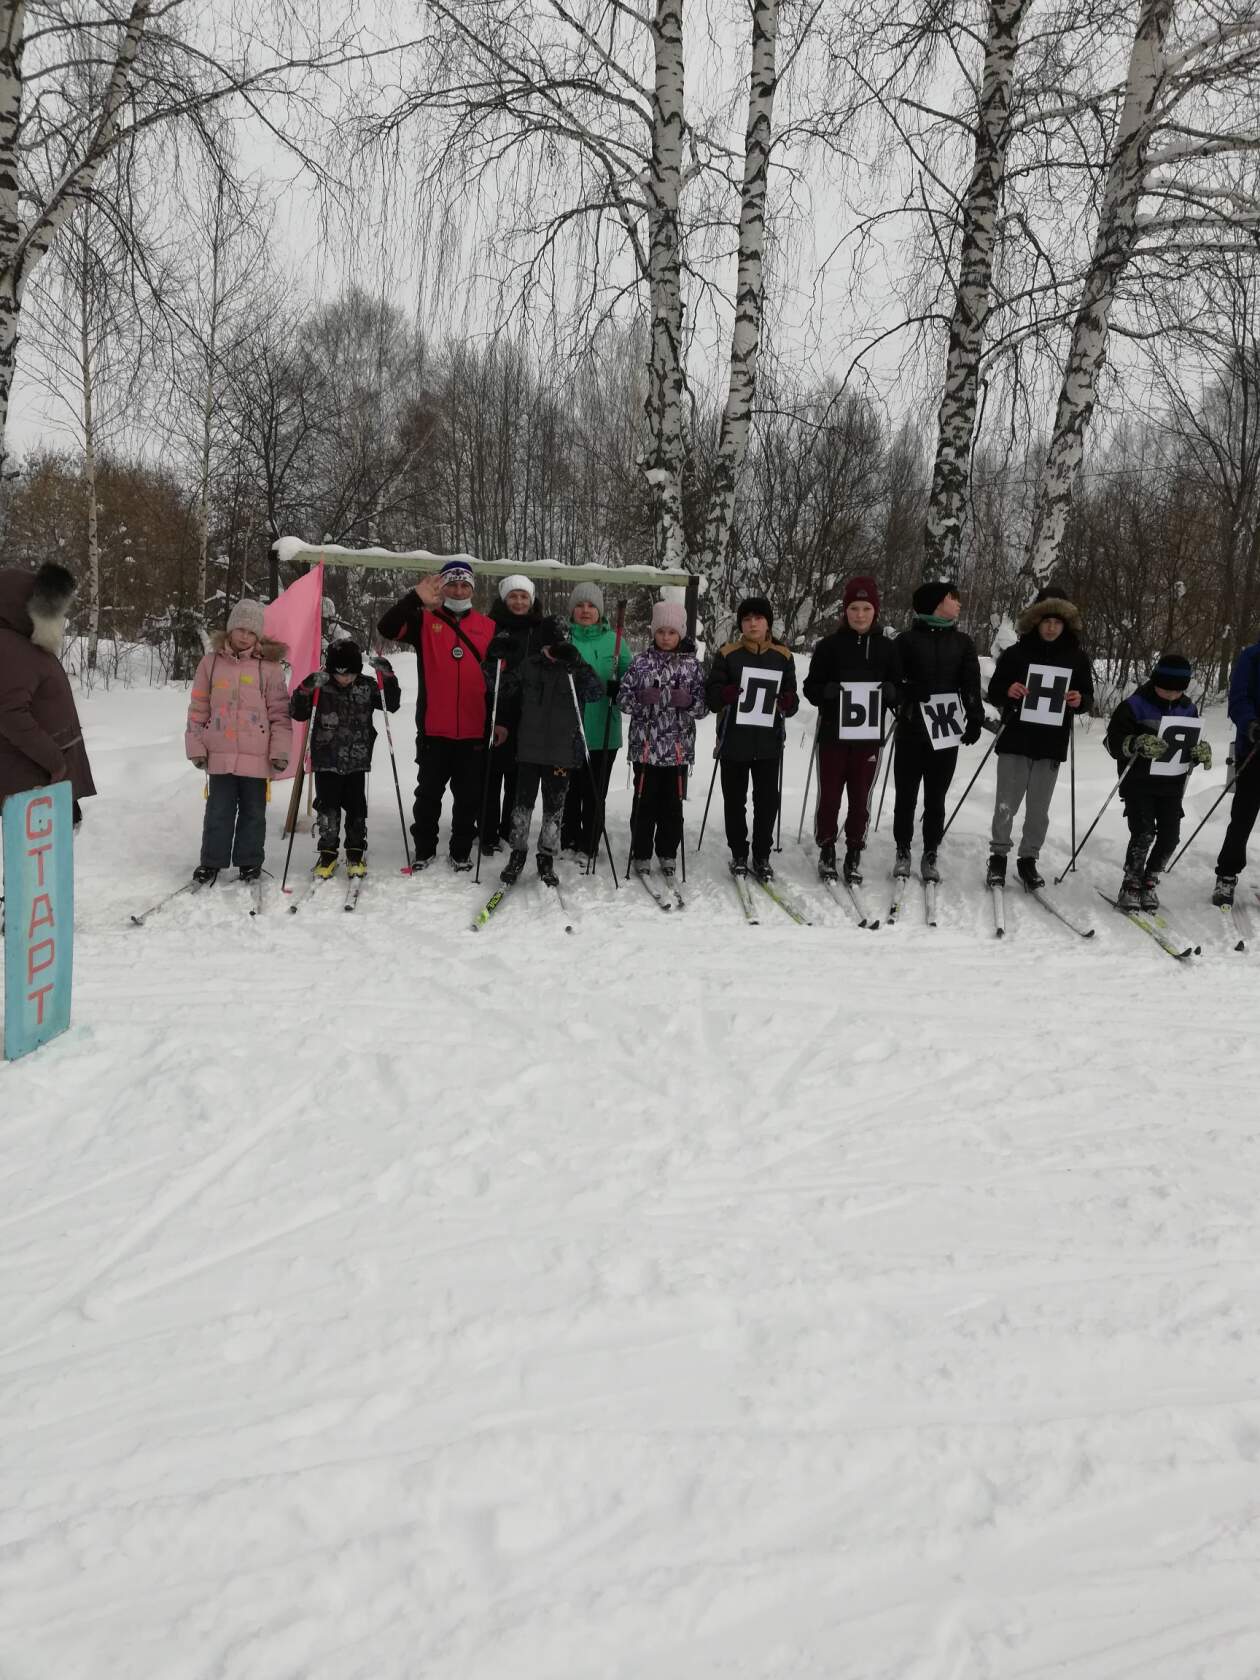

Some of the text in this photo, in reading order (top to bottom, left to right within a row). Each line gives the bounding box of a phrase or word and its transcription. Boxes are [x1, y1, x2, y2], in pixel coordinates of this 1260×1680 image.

[739, 677, 778, 714] Л
[841, 690, 880, 727] Ы
[1024, 673, 1068, 713] Н
[924, 701, 963, 739] Ж
[1160, 725, 1201, 763] Я
[26, 795, 55, 1025] СТАРТ
